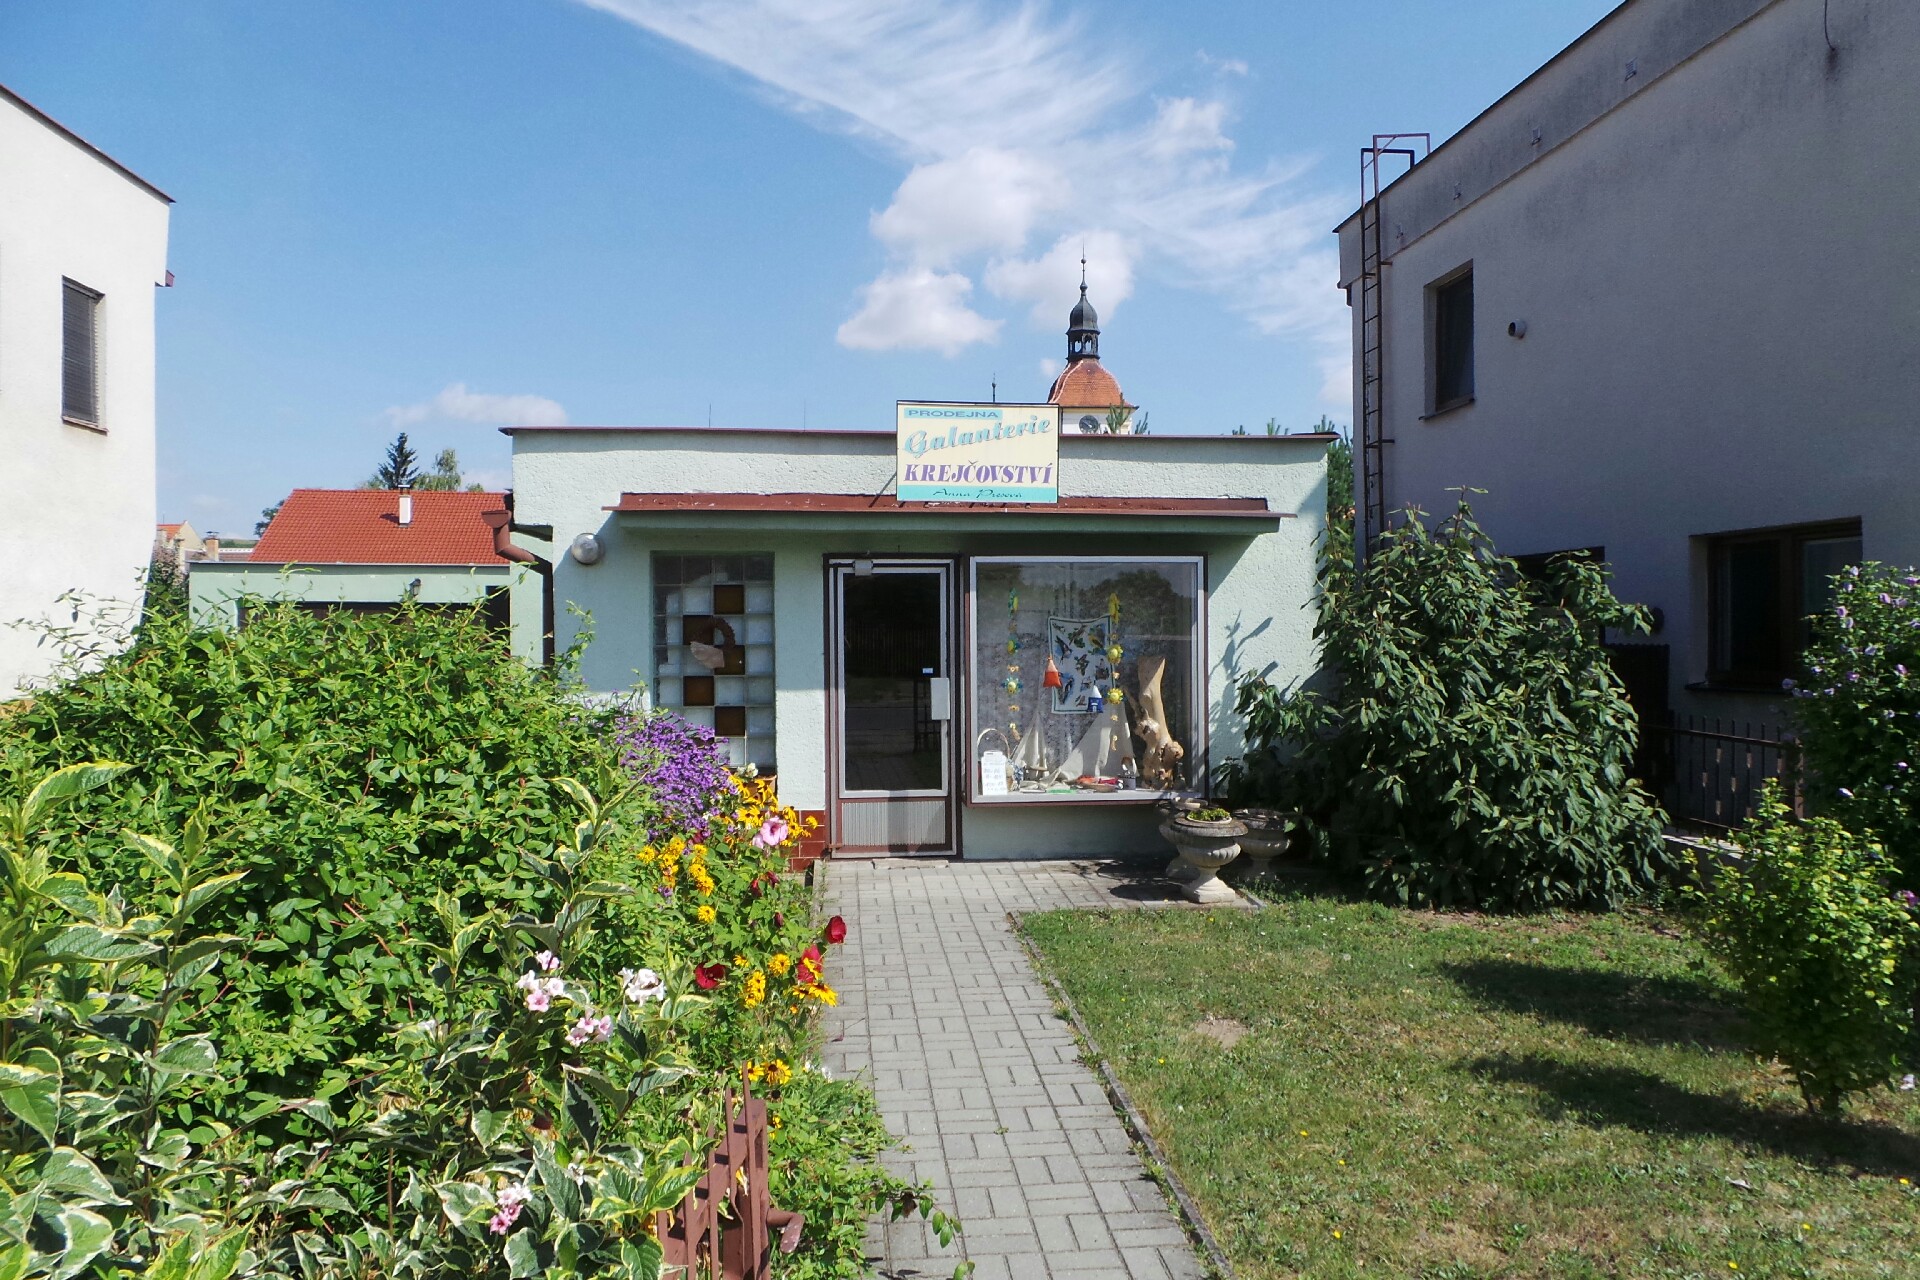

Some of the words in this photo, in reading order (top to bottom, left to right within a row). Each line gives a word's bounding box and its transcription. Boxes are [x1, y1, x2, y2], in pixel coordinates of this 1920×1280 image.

[908, 410, 998, 418] PRODEJNA
[905, 415, 1053, 458] Galanterie
[904, 460, 1053, 483] KREJČOVSTVÍ
